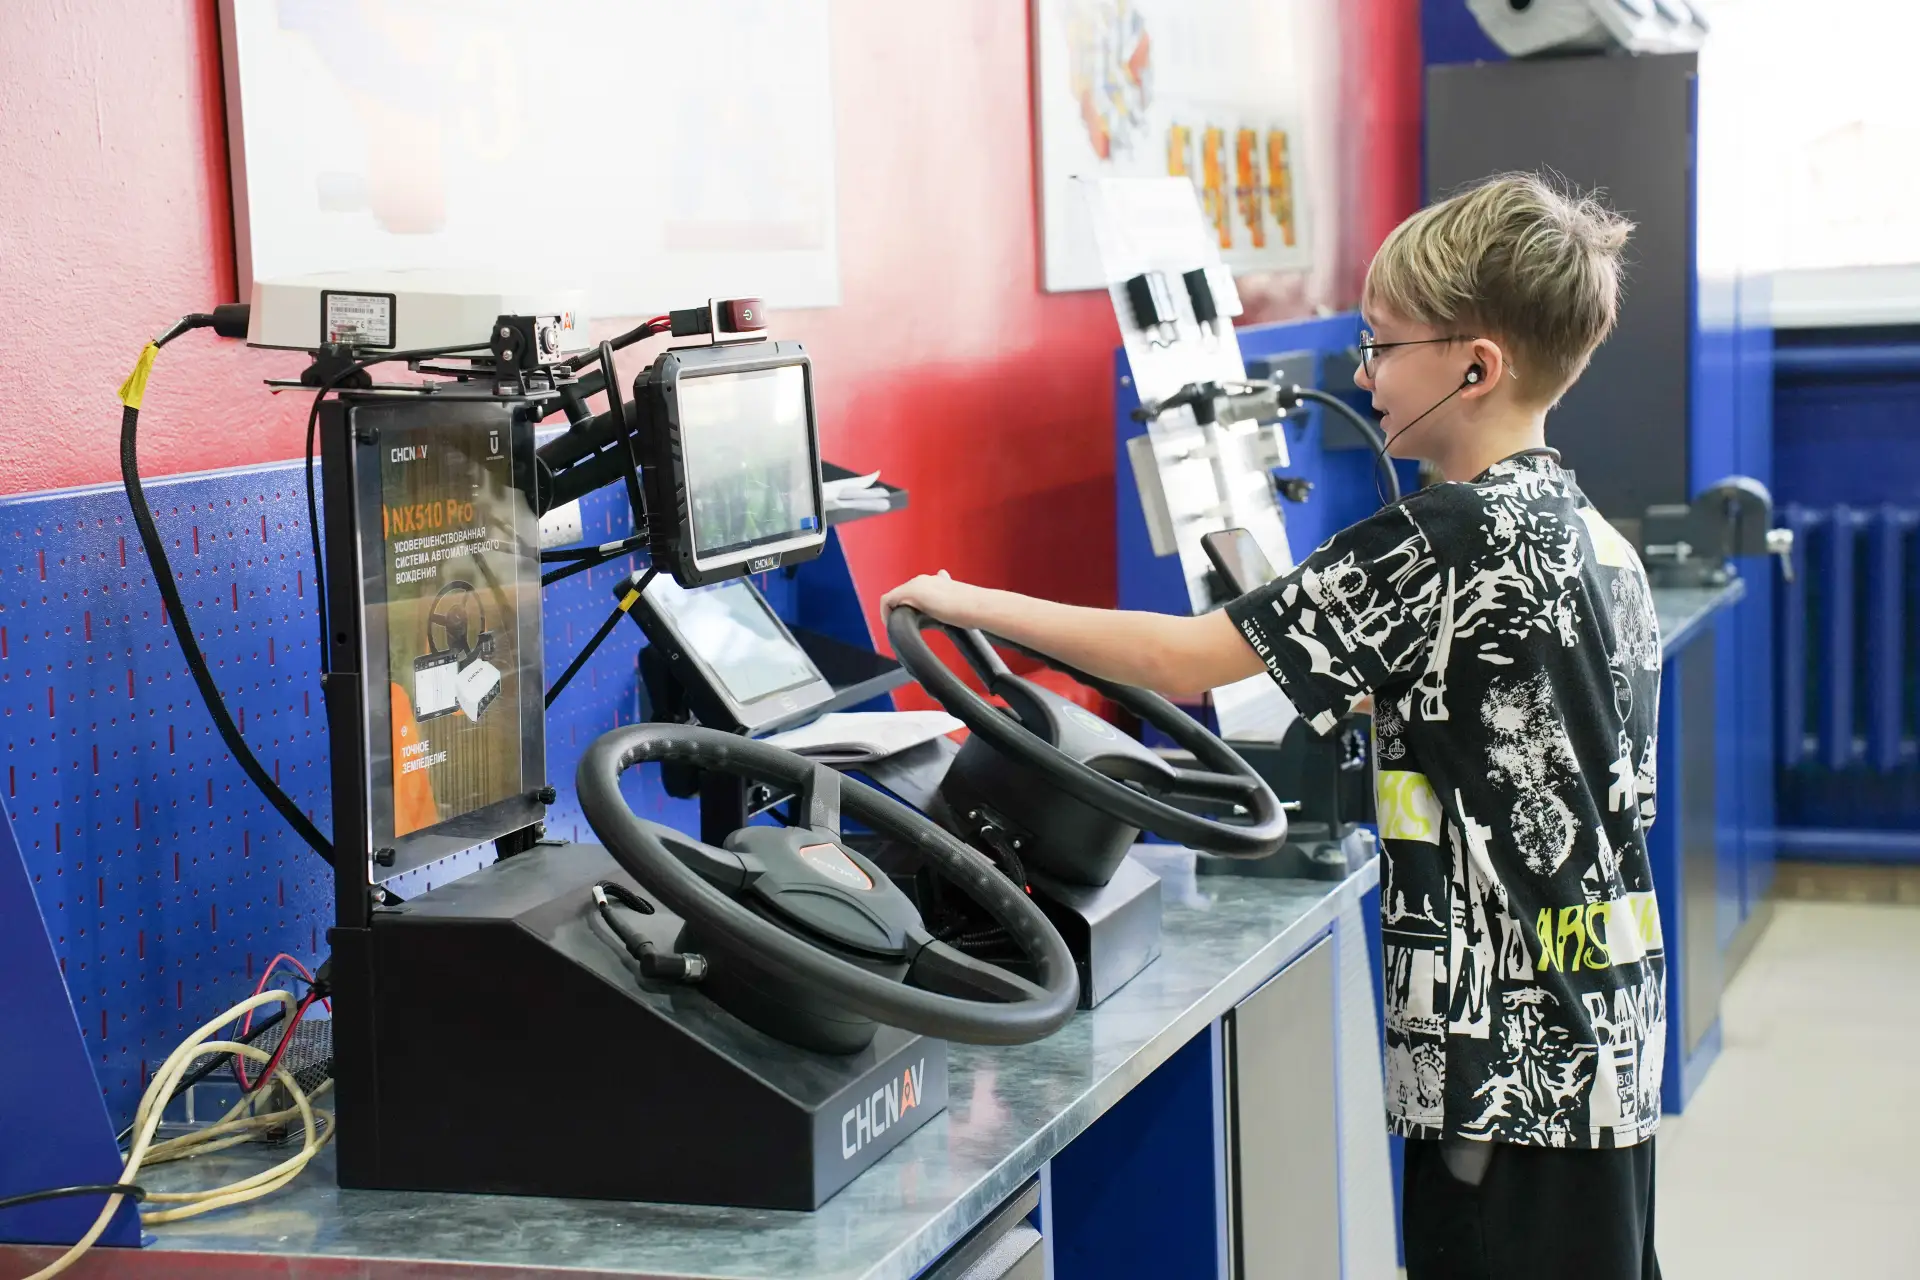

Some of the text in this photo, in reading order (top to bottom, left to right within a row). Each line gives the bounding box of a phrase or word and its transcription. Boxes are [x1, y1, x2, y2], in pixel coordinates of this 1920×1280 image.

[390, 444, 428, 463] CHCNAV
[392, 499, 473, 535] NX510 Pro
[394, 526, 486, 554] УСОВЕРШЕНСТВОВАННАЯ
[395, 539, 500, 569] СИСТЕМА АВТОМАТИЧЕСКОГО
[395, 565, 437, 585] ВОЖДЕНИЯ
[1240, 619, 1270, 657] sand
[401, 739, 430, 759] ТОЧНОЕ
[401, 750, 447, 775] ЗЕМЛЕДЕЛИЕ
[841, 1057, 925, 1160] CHCNAV
